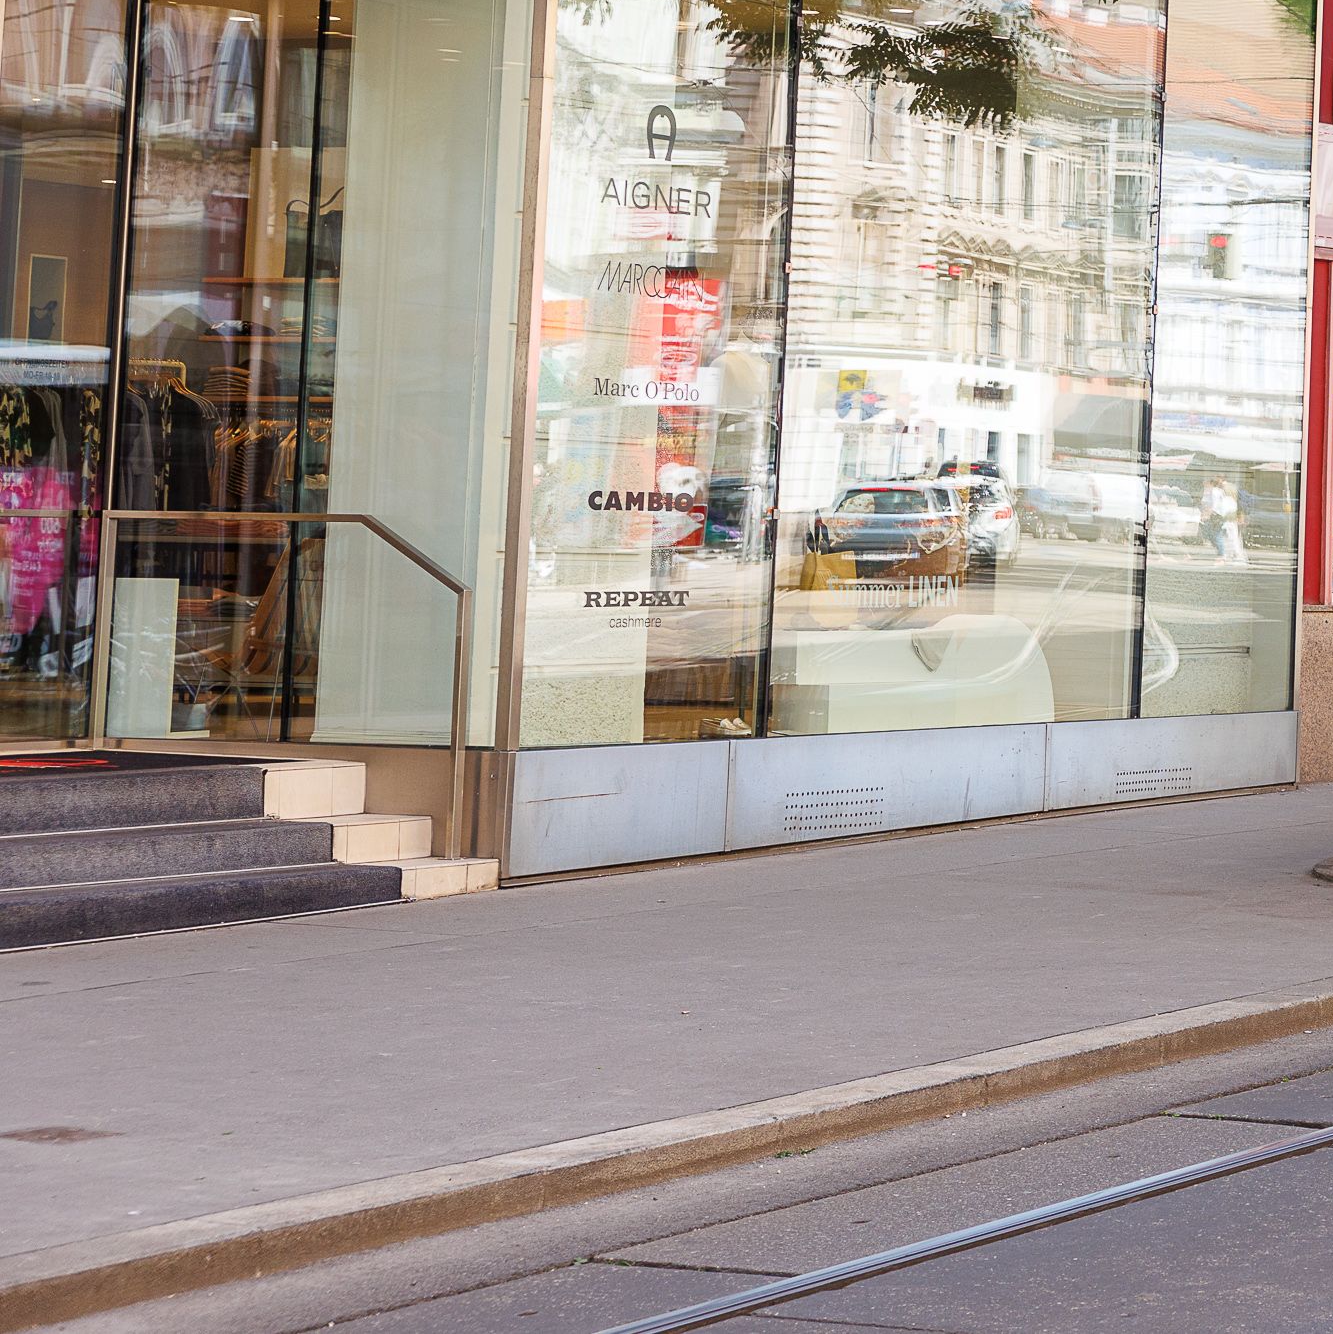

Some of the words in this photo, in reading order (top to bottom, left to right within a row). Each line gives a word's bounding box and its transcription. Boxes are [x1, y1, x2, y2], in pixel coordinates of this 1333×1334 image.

[601, 177, 711, 218] AIGNER
[593, 377, 639, 398] Marc
[645, 380, 700, 402] O'Polo
[588, 490, 694, 512] CAMBIO
[826, 575, 904, 608] Summer
[908, 565, 959, 608] LINEN
[583, 590, 689, 608] REPEAT
[609, 616, 662, 628] cashmere
